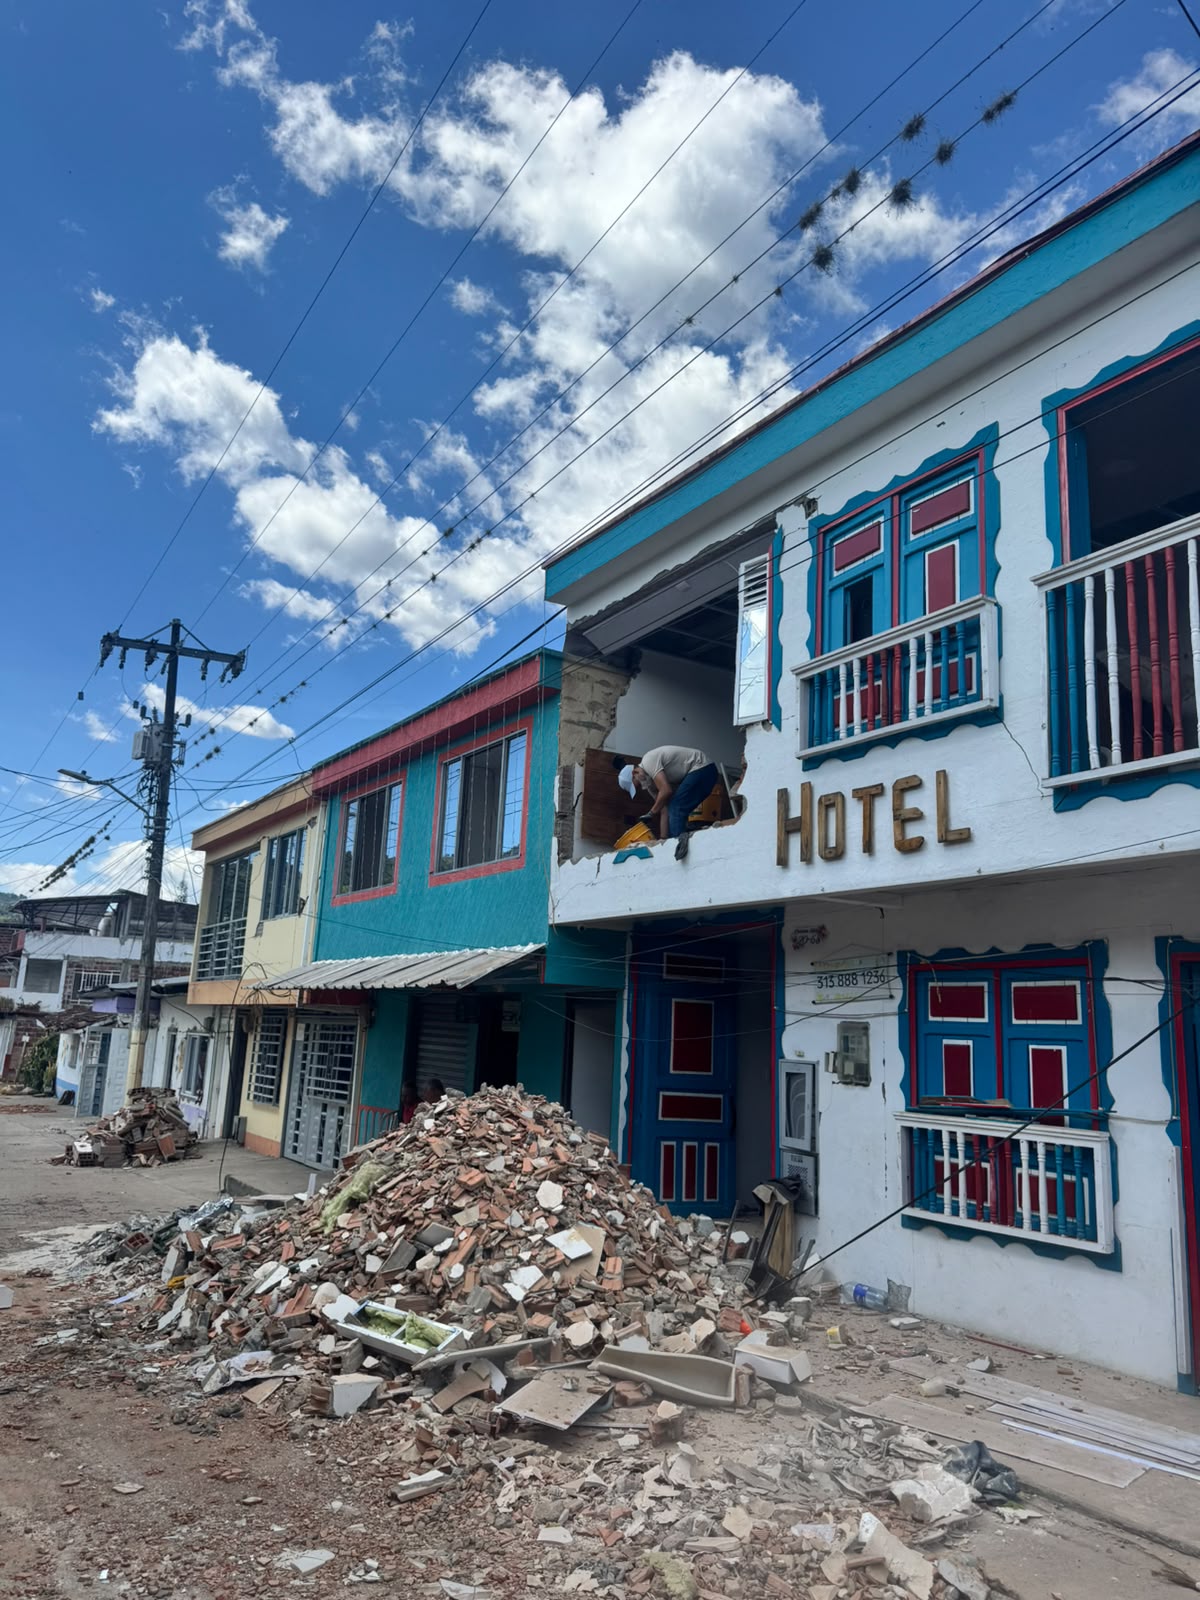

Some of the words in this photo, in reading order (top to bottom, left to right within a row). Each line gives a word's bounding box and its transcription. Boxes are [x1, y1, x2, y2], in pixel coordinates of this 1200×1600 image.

[776, 769, 971, 867] HOTEL
[816, 975, 835, 989] 313
[837, 972, 858, 987] 888
[862, 969, 886, 985] 1236
